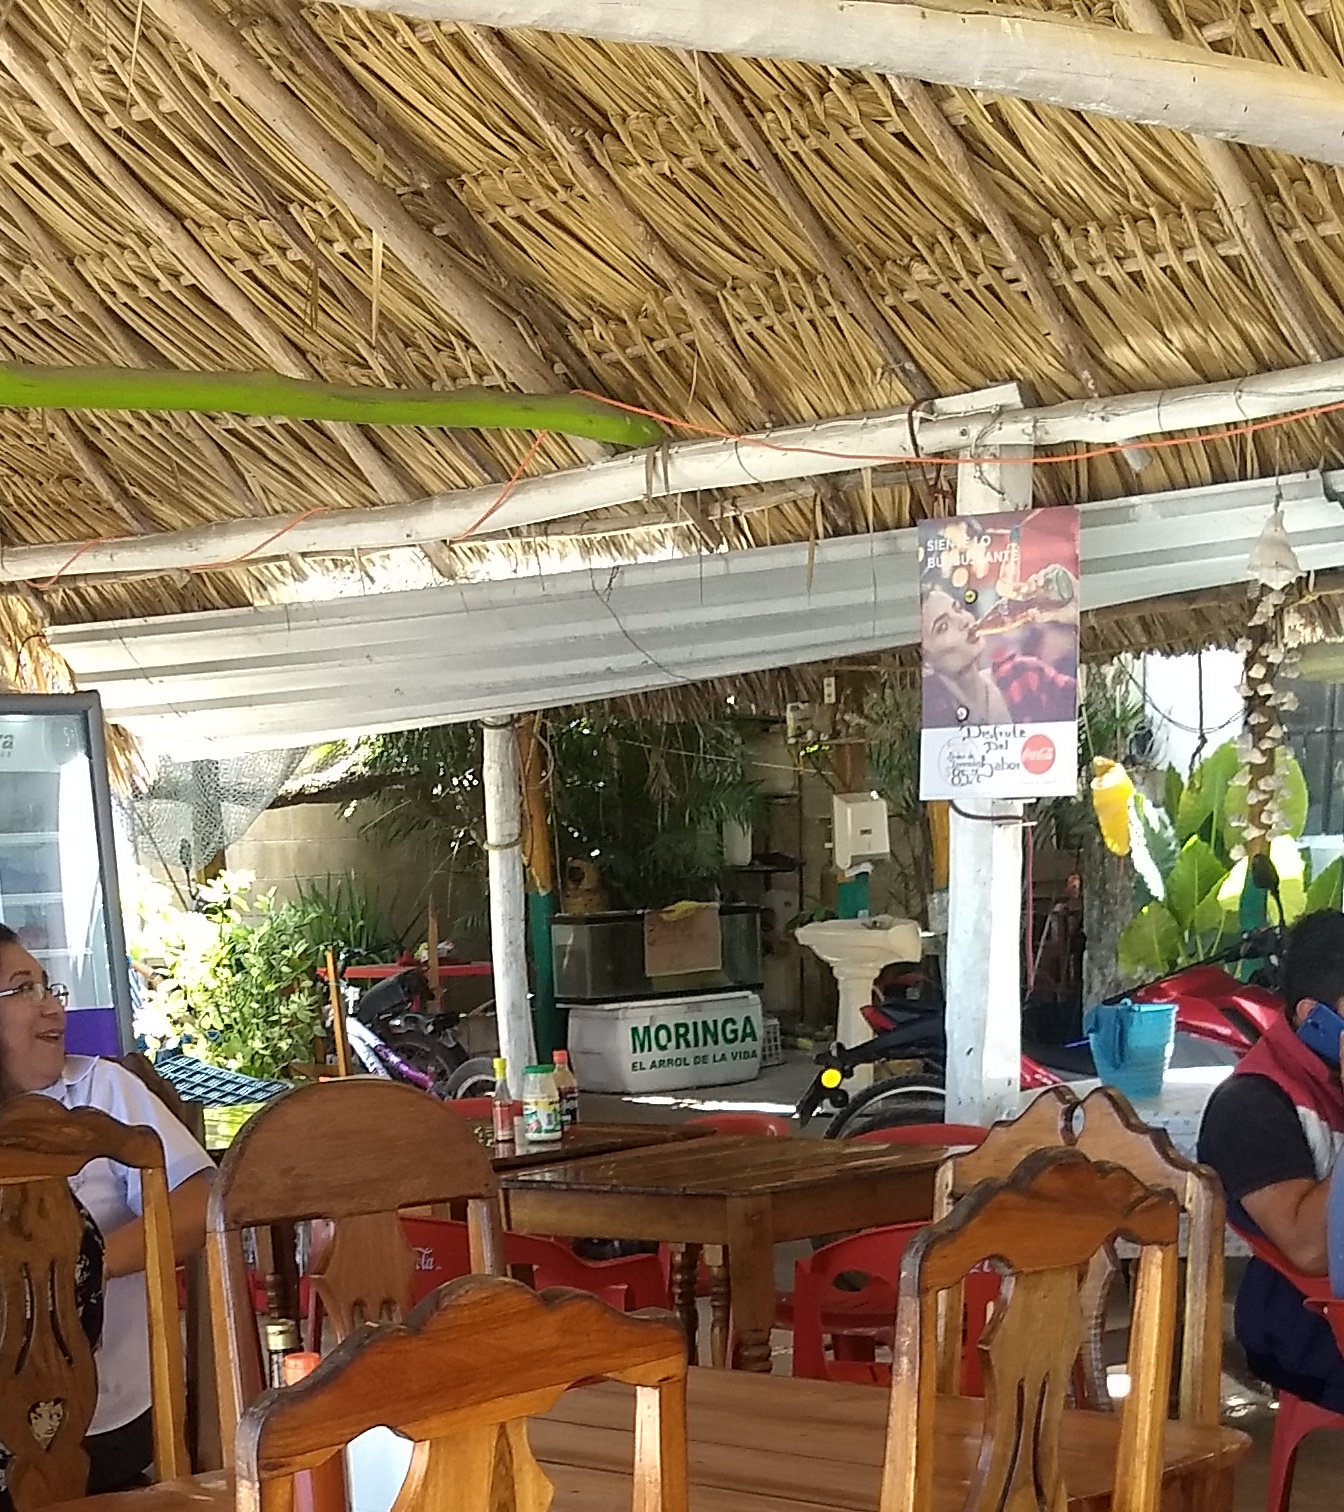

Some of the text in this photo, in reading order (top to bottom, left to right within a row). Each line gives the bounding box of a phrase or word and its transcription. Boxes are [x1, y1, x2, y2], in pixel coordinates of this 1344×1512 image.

[974, 535, 992, 547] LO
[630, 1015, 758, 1054] MORINGA
[630, 1061, 646, 1072] EL
[693, 1054, 709, 1065] DE
[712, 1053, 727, 1063] LA
[730, 1049, 758, 1061] VIDA
